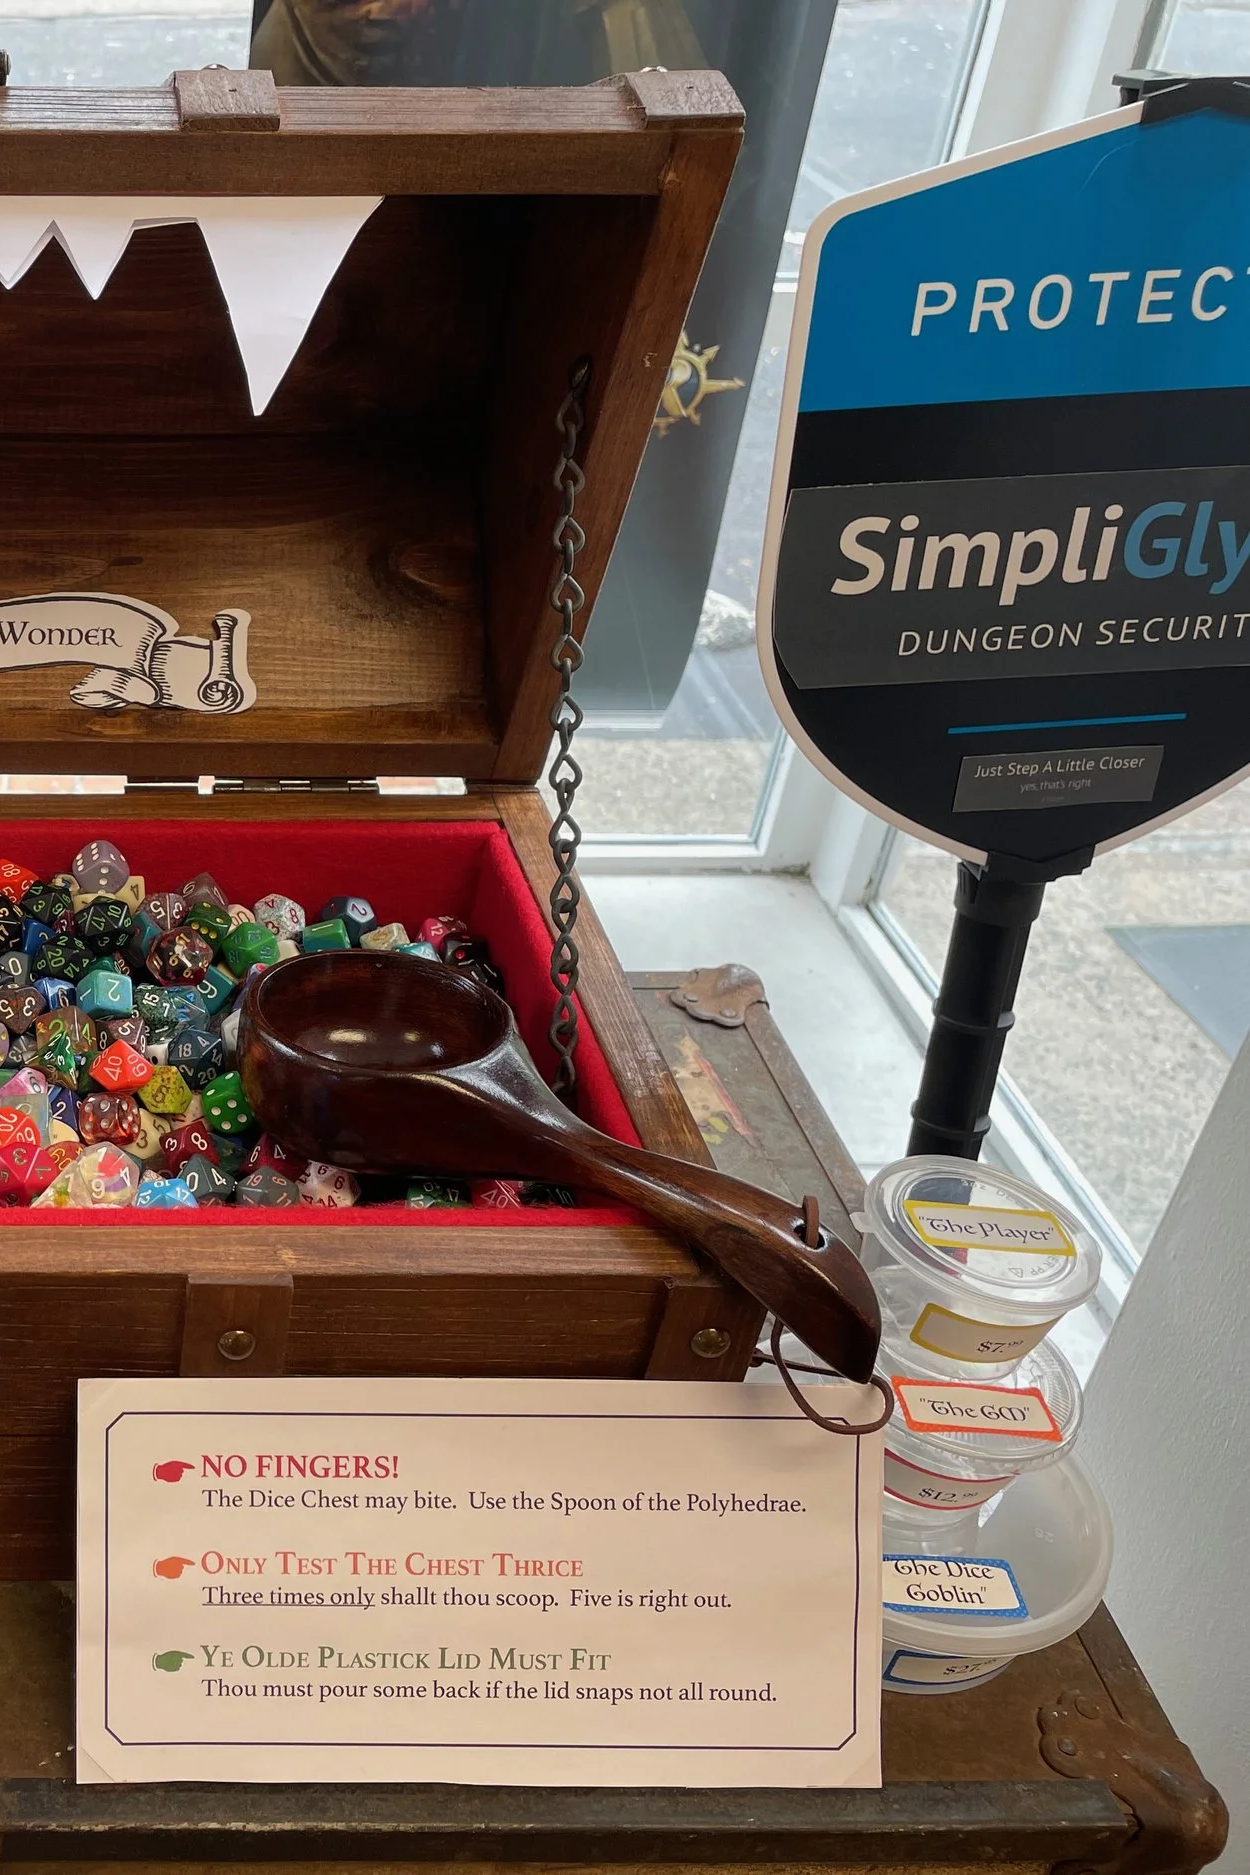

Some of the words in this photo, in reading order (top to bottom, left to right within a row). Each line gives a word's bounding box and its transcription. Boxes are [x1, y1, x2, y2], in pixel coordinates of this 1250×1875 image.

[911, 266, 1250, 337] PROTEC
[899, 622, 1083, 656] DUNGEON
[974, 765, 1003, 778] Just
[1007, 762, 1039, 777] Step
[1042, 761, 1053, 774] A
[1057, 758, 1095, 773] Little
[1099, 756, 1146, 770] Closer
[1040, 779, 1066, 792] that's
[1068, 778, 1092, 791] right
[48, 949, 66, 968] 20
[107, 979, 121, 1002] 2
[178, 1043, 192, 1058] 18
[52, 1101, 67, 1120] 2
[210, 1168, 227, 1186] 4
[918, 1214, 976, 1235] "The
[978, 1221, 1054, 1243] Player"
[919, 1397, 979, 1419] "The
[201, 1455, 247, 1478] NO
[256, 1455, 399, 1479] FINGERS!
[202, 1489, 242, 1508] The
[249, 1490, 295, 1508] Dice
[302, 1490, 359, 1509] Chest
[365, 1495, 408, 1515] may
[414, 1490, 457, 1509] bite.
[469, 1491, 506, 1510] Use
[512, 1491, 545, 1510] the
[550, 1491, 617, 1517] Spoon
[623, 1492, 644, 1511] of
[646, 1493, 681, 1512] the
[687, 1493, 807, 1518] Polyhedrae.
[947, 1560, 995, 1581] Dice
[202, 1586, 263, 1605] Three
[269, 1587, 325, 1605] times
[329, 1587, 376, 1611] only
[381, 1587, 437, 1606] shallt
[443, 1587, 491, 1606] thou
[496, 1592, 559, 1612] scoop.
[570, 1588, 612, 1608] Five
[617, 1589, 634, 1608] is
[639, 1588, 688, 1613] right
[694, 1593, 732, 1608] out.
[906, 1582, 988, 1605] Goblin"
[201, 1679, 257, 1697] Thou
[263, 1682, 313, 1698] must
[319, 1684, 368, 1703] pour
[374, 1686, 427, 1698] some
[433, 1680, 480, 1699] back
[486, 1680, 501, 1699] if
[505, 1681, 538, 1699] the
[543, 1681, 570, 1700] lid
[576, 1686, 633, 1706] snaps
[639, 1685, 673, 1701] not
[678, 1681, 704, 1701] all
[709, 1682, 777, 1702] round.
